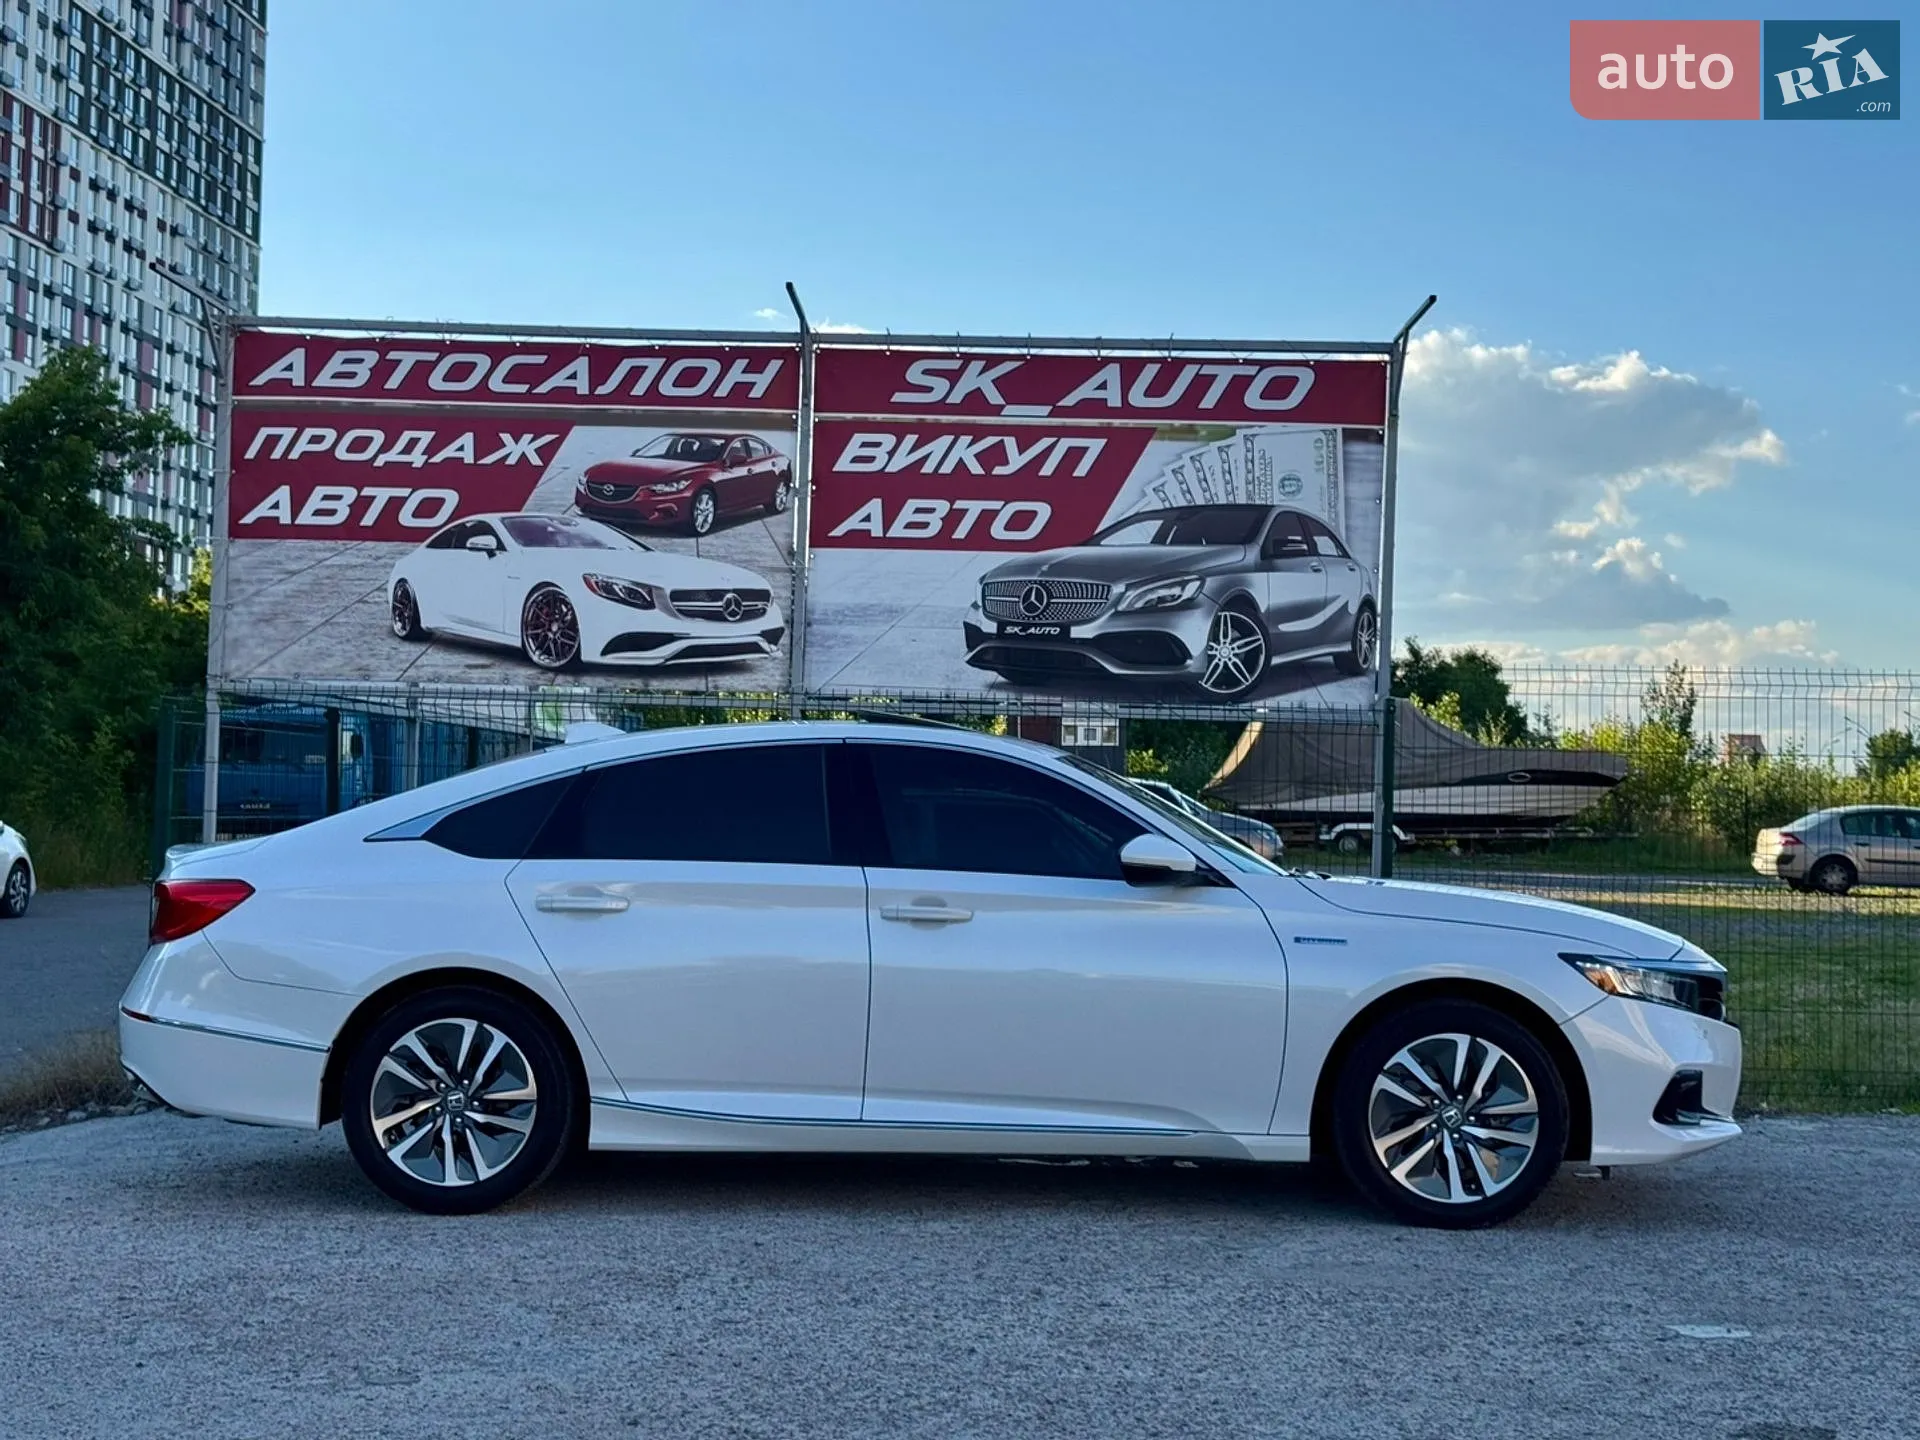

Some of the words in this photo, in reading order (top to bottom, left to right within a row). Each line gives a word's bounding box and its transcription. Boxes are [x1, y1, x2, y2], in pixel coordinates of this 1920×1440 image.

[249, 347, 784, 399] АВТОСАЛОН
[891, 358, 1316, 417] SK_AUTO
[243, 426, 559, 467] ПРОДАЖ
[832, 433, 1107, 478] ВИКУП
[238, 484, 460, 528] АВТО
[827, 497, 1052, 541] АВТО
[1003, 625, 1061, 636] SK_AUTO
